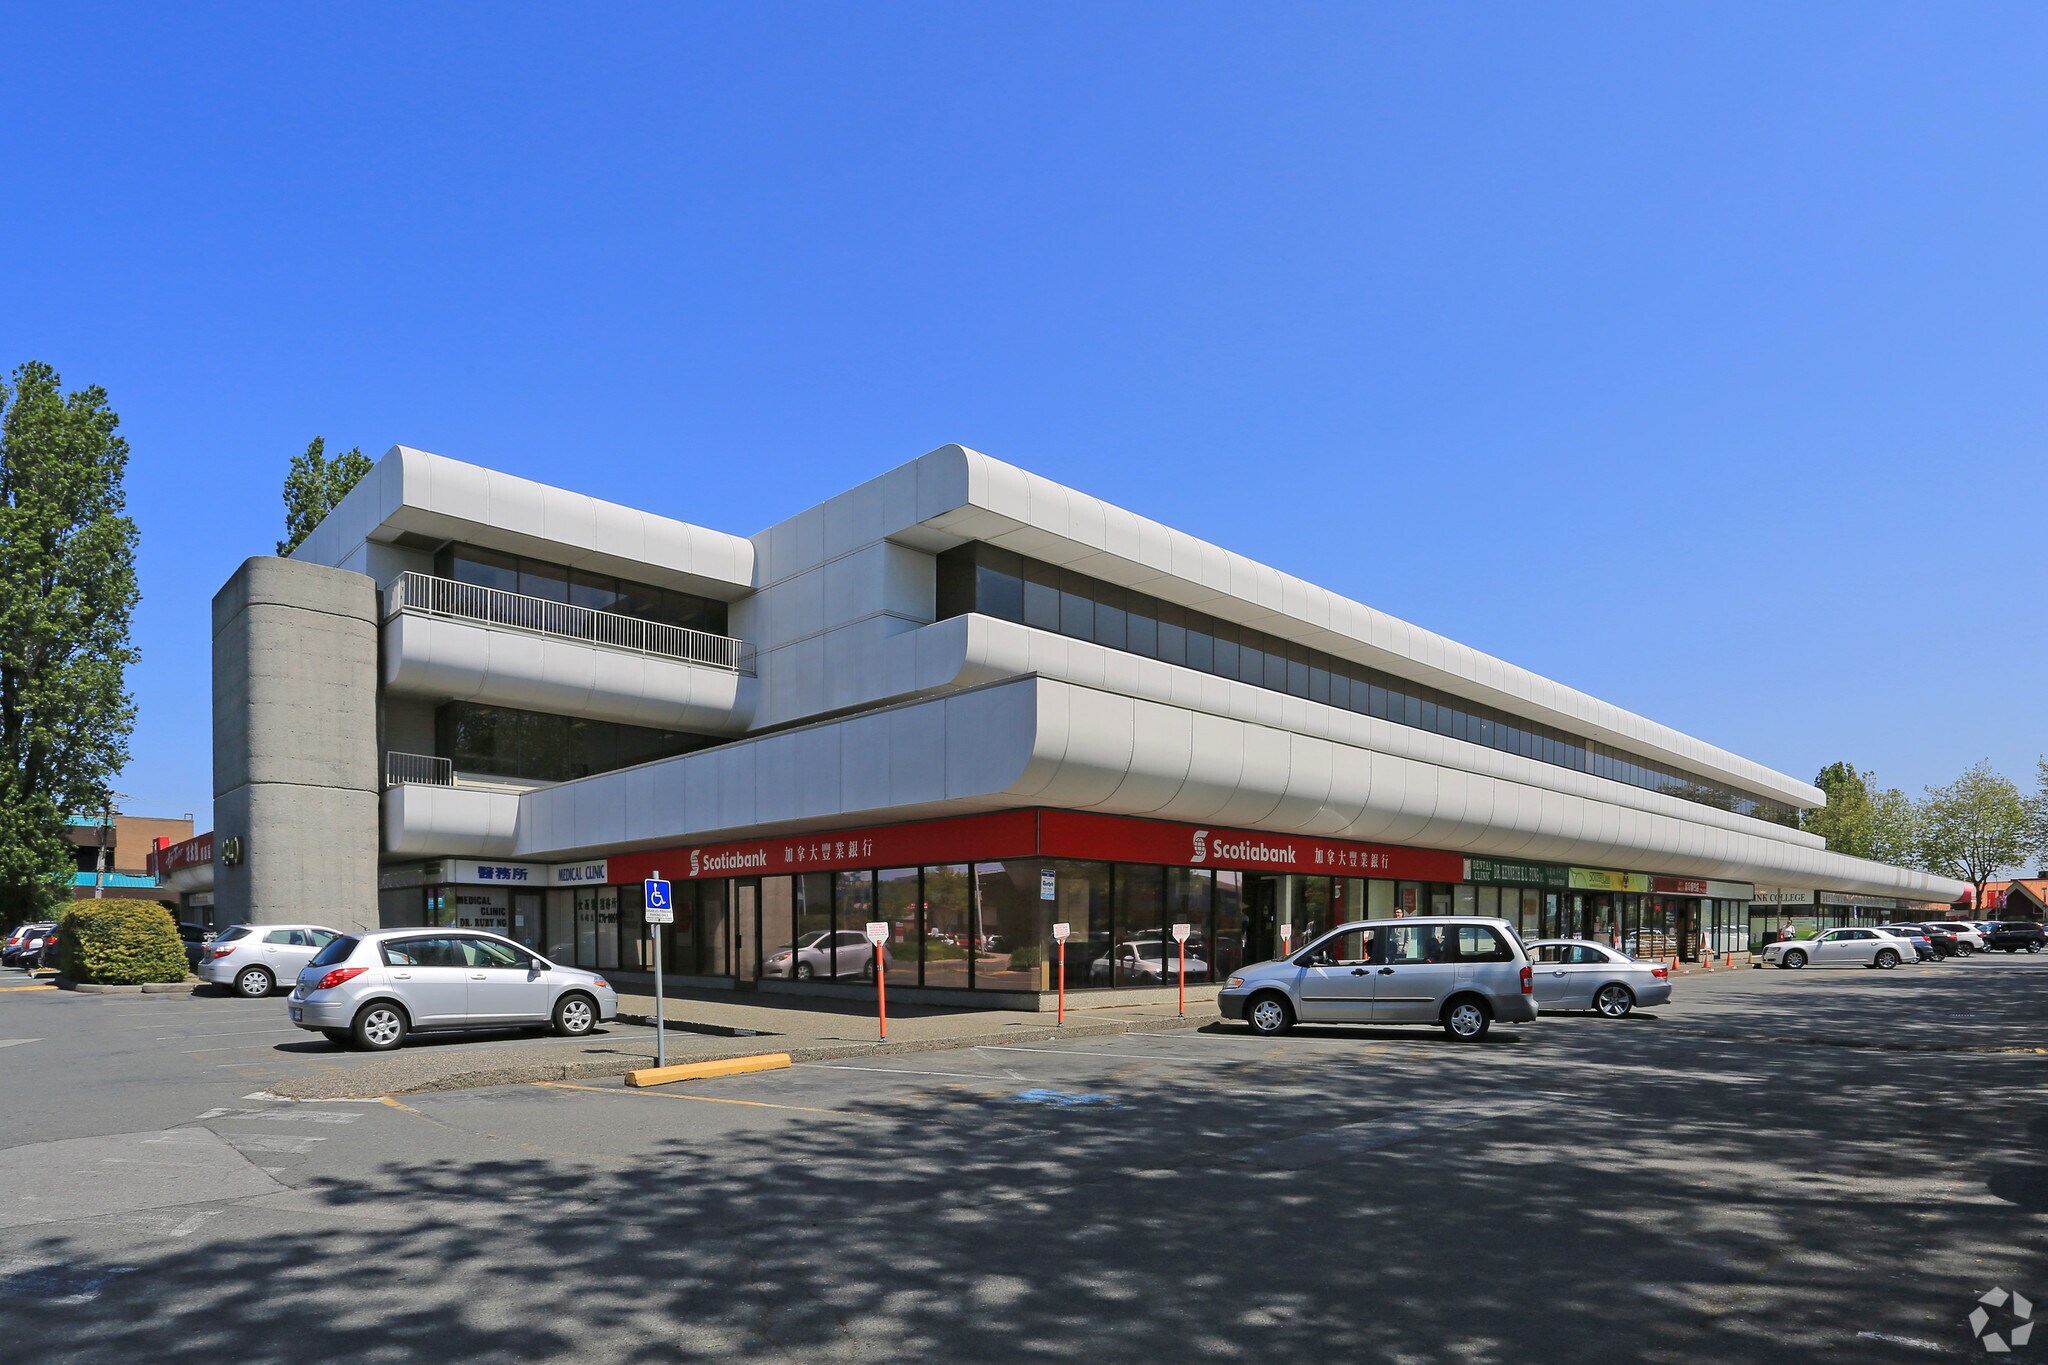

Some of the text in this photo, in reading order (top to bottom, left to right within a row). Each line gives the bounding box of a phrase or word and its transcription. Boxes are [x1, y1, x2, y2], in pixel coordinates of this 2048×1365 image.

[784, 838, 873, 863] 加拿大豐業銀行
[1213, 838, 1296, 864] Scotiabank
[1314, 847, 1390, 869] 加拿大豐業銀行
[703, 848, 767, 871] Scotiabank
[1472, 860, 1492, 871] DENTAL
[478, 865, 528, 881] 醫務所
[558, 864, 605, 882] MEDICAL CLINIC
[457, 895, 491, 906] MEDICAL
[1769, 893, 1806, 902] COLLEGE
[480, 907, 506, 916] CLINIC
[459, 918, 507, 927] DR. RUBY NG
